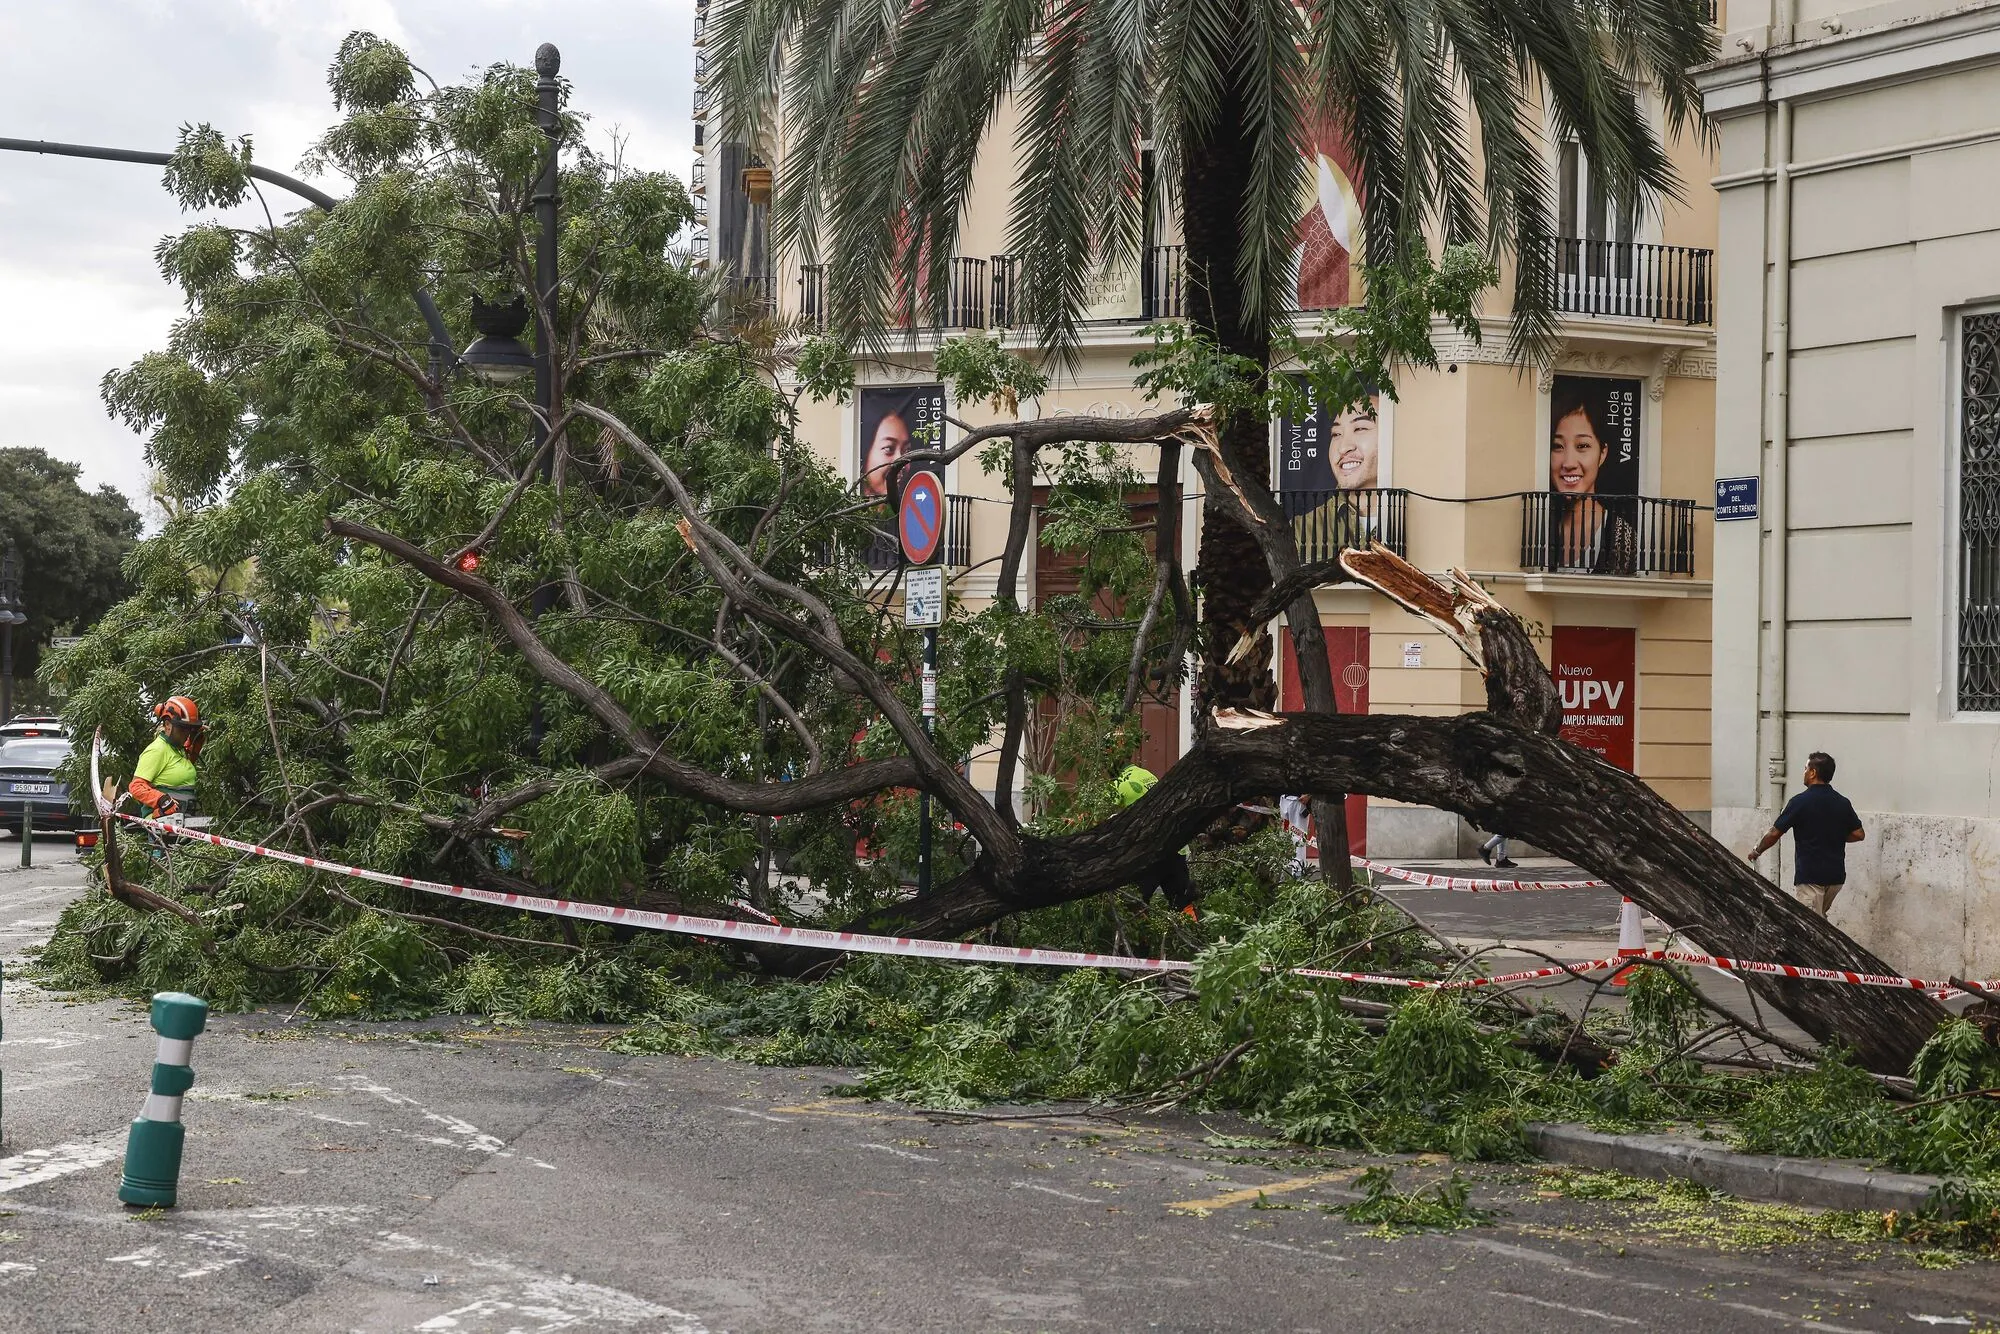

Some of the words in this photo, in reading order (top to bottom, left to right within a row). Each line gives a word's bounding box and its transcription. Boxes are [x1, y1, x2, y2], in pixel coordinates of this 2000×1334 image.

[1085, 294, 1126, 306] ALÈNCIA
[916, 397, 927, 430] Hola
[1607, 391, 1620, 426] Hola
[930, 397, 941, 464] alencia
[1304, 427, 1317, 442] la
[1619, 391, 1633, 463] Valencia
[1307, 447, 1317, 458] a
[1717, 506, 1731, 514] COMTE
[1732, 505, 1738, 513] DE
[1739, 503, 1757, 512] TRÉNOR
[1558, 663, 1593, 676] Nuevo
[1558, 679, 1624, 710] UPV
[1562, 714, 1586, 726] AMPUS
[1587, 715, 1624, 726] HANGZHOU
